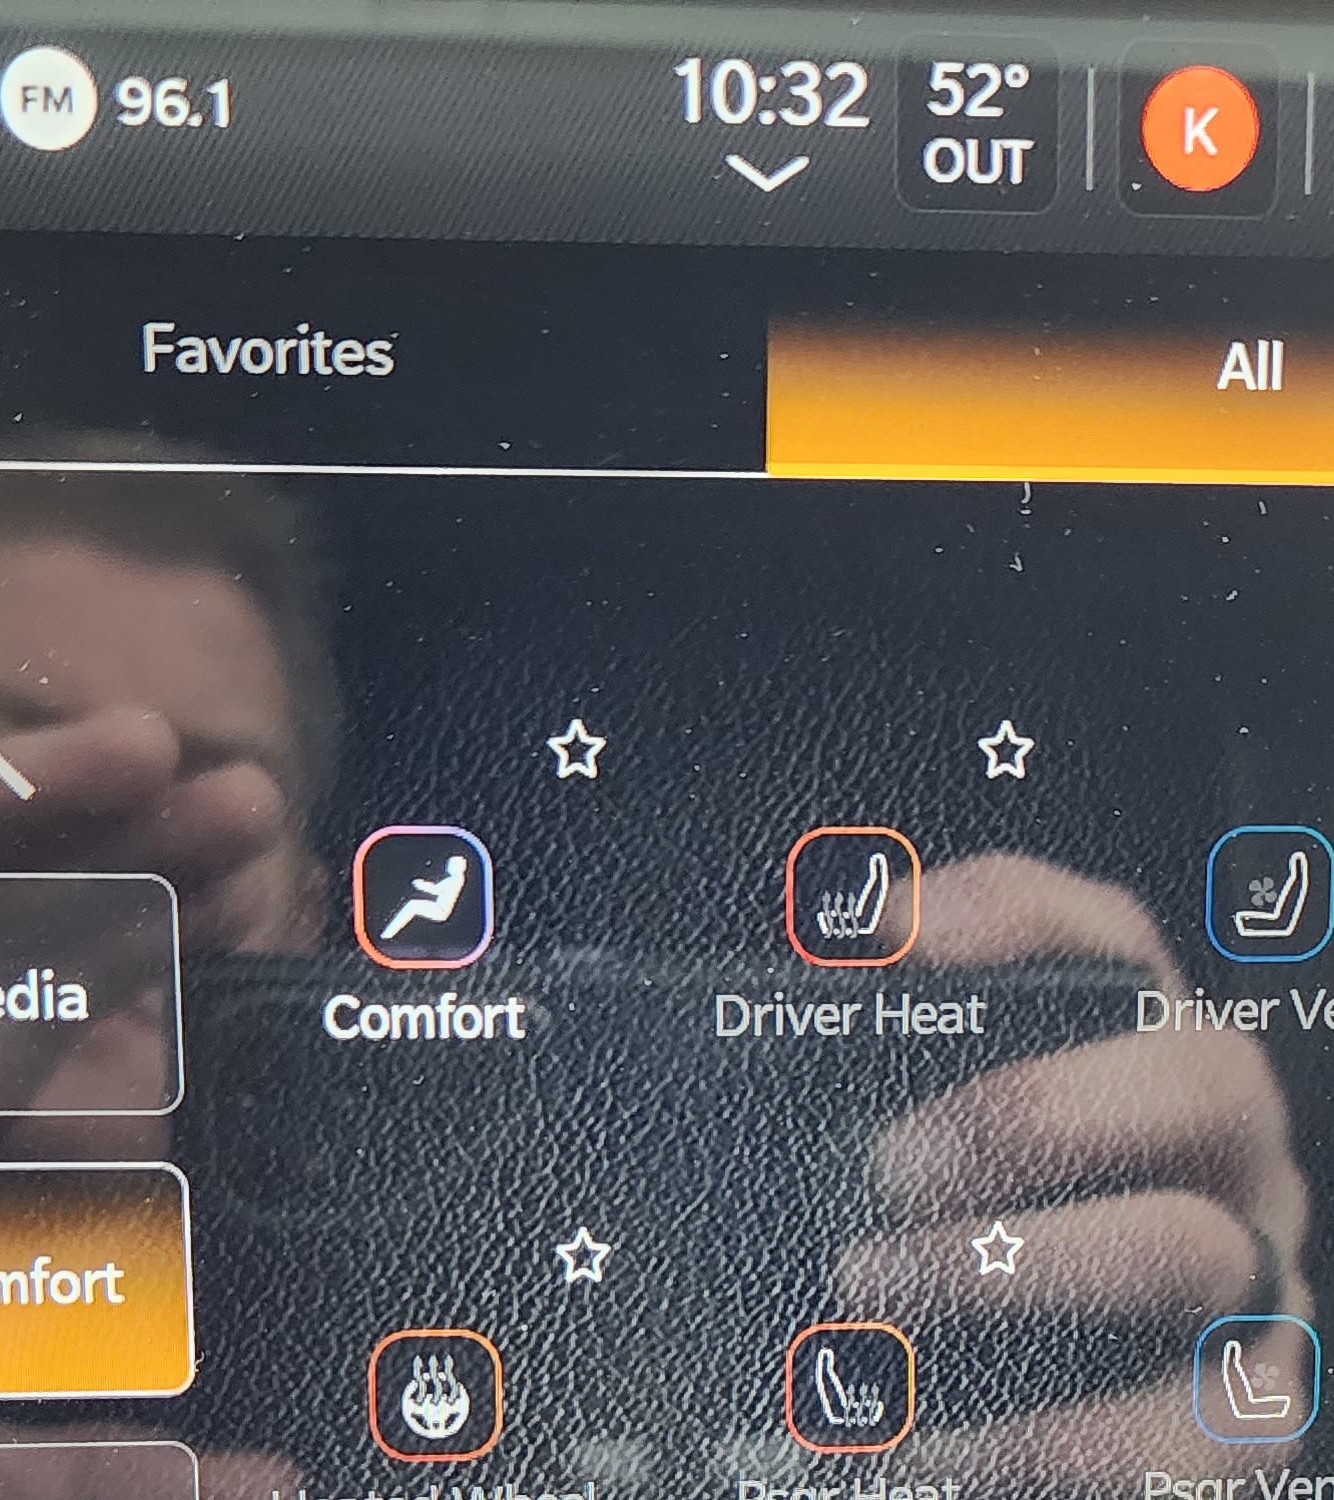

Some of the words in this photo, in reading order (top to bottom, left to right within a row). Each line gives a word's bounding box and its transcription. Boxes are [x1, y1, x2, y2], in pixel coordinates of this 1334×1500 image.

[20, 85, 74, 114] FM
[116, 78, 231, 128] 96.1
[673, 58, 869, 127] 10:32
[927, 62, 1029, 117] 52°
[1181, 107, 1218, 155] K
[924, 138, 1033, 183] OUT
[142, 322, 395, 377] Favorites
[1216, 340, 1284, 391] All
[323, 993, 527, 1041] Comfort
[714, 993, 861, 1037] Driver
[875, 993, 985, 1036] Heat
[1136, 988, 1279, 1032] Driver
